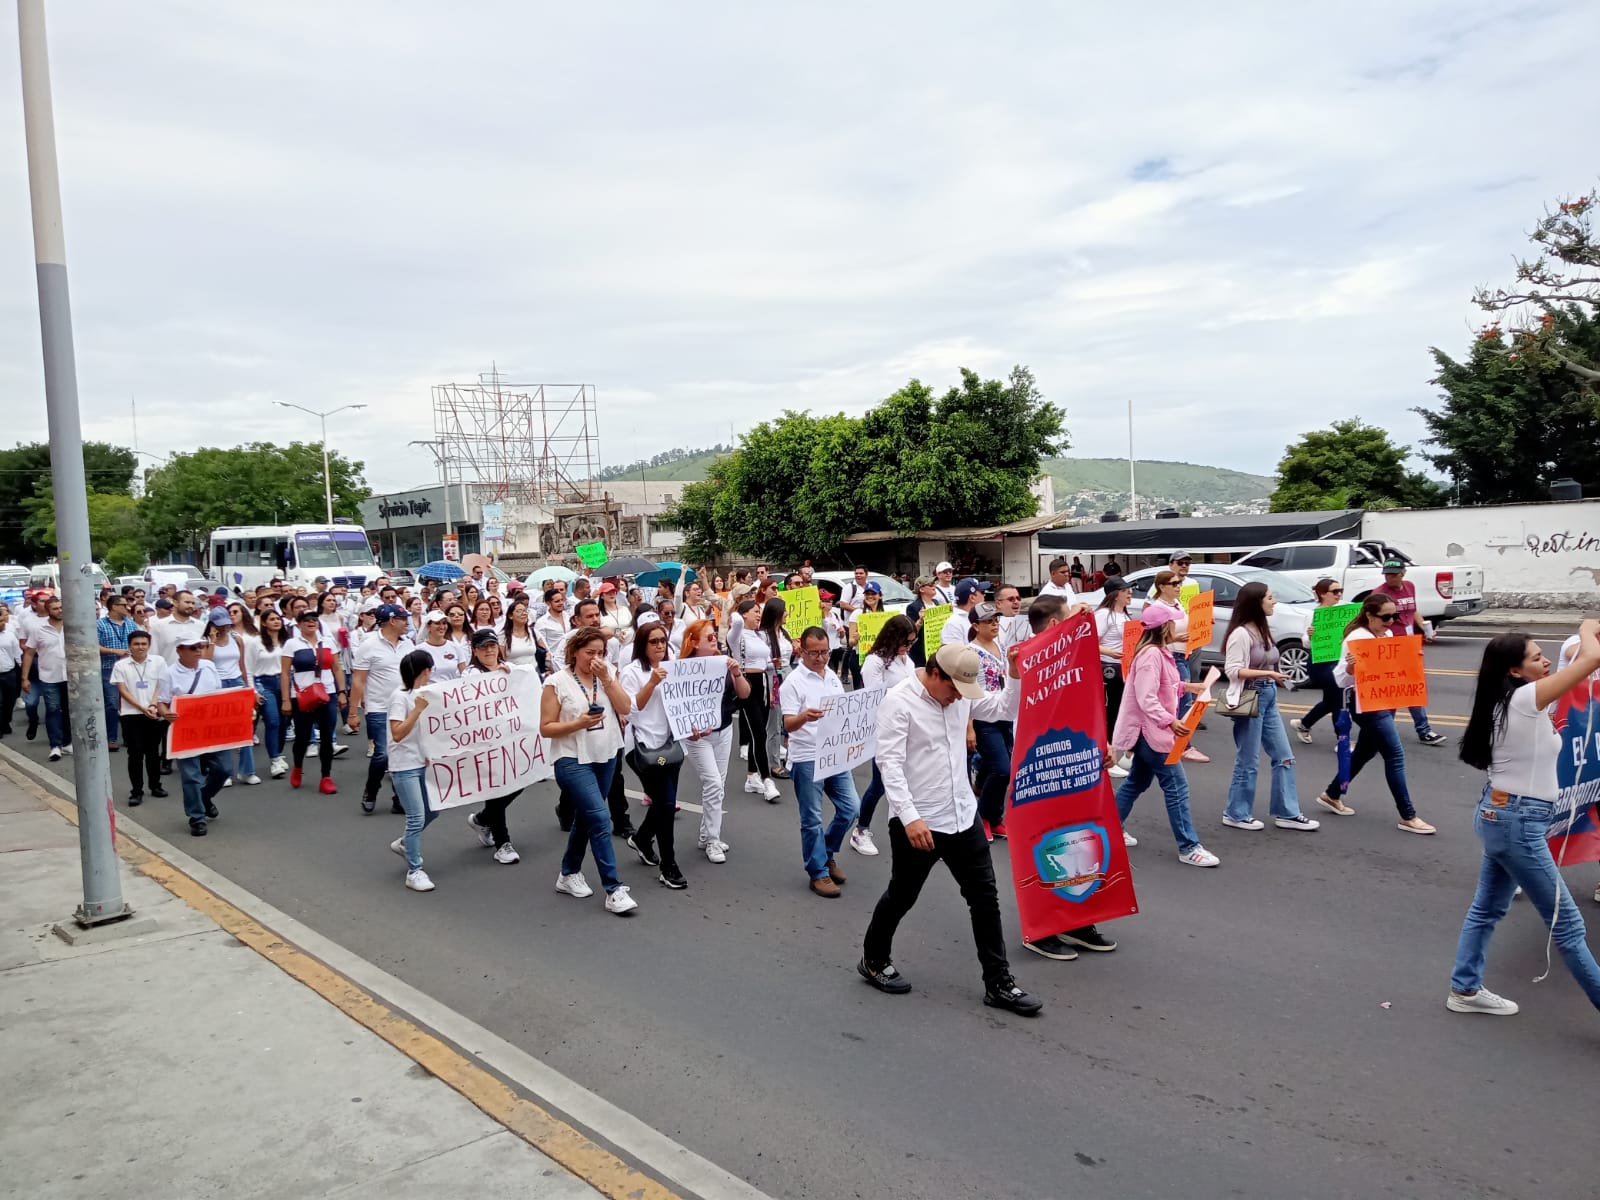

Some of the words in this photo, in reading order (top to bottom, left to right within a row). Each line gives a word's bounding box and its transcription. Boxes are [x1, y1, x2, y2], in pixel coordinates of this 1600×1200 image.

[408, 498, 431, 518] Tepic
[796, 590, 805, 600] EL
[789, 600, 812, 618] PJF
[1022, 631, 1074, 674] SECCIÓN
[1075, 622, 1092, 640] 22
[1378, 644, 1401, 660] PJF
[674, 661, 687, 677] NO
[687, 660, 706, 675] SON
[1037, 651, 1071, 684] TEPIC
[443, 677, 507, 708] MÉXICO
[662, 676, 724, 700] PRIVILEGIOS
[1026, 666, 1084, 709] NAYARIT
[1370, 683, 1424, 699] AMPARAR?
[428, 695, 519, 734] DESPIERTA
[669, 704, 682, 717] SON
[683, 697, 717, 714] NUESTROS
[450, 724, 502, 749] SOMOS
[507, 716, 521, 733] TU
[841, 717, 850, 732] A
[857, 713, 867, 728] LA
[819, 753, 837, 769] DEL
[847, 743, 865, 762] PJF
[1036, 740, 1072, 757] EXIGIMOS
[1572, 735, 1587, 766] EL
[432, 733, 545, 803] DEFENSA
[1016, 766, 1028, 780] CESE
[1029, 763, 1034, 773] A
[1035, 760, 1043, 771] LA
[1045, 748, 1092, 769] INTROMISIÓN
[1036, 768, 1064, 783] PORQUE
[1065, 762, 1091, 777] AFECTA
[1016, 781, 1060, 801] IMPARTICIÓN
[1062, 779, 1072, 790] DE
